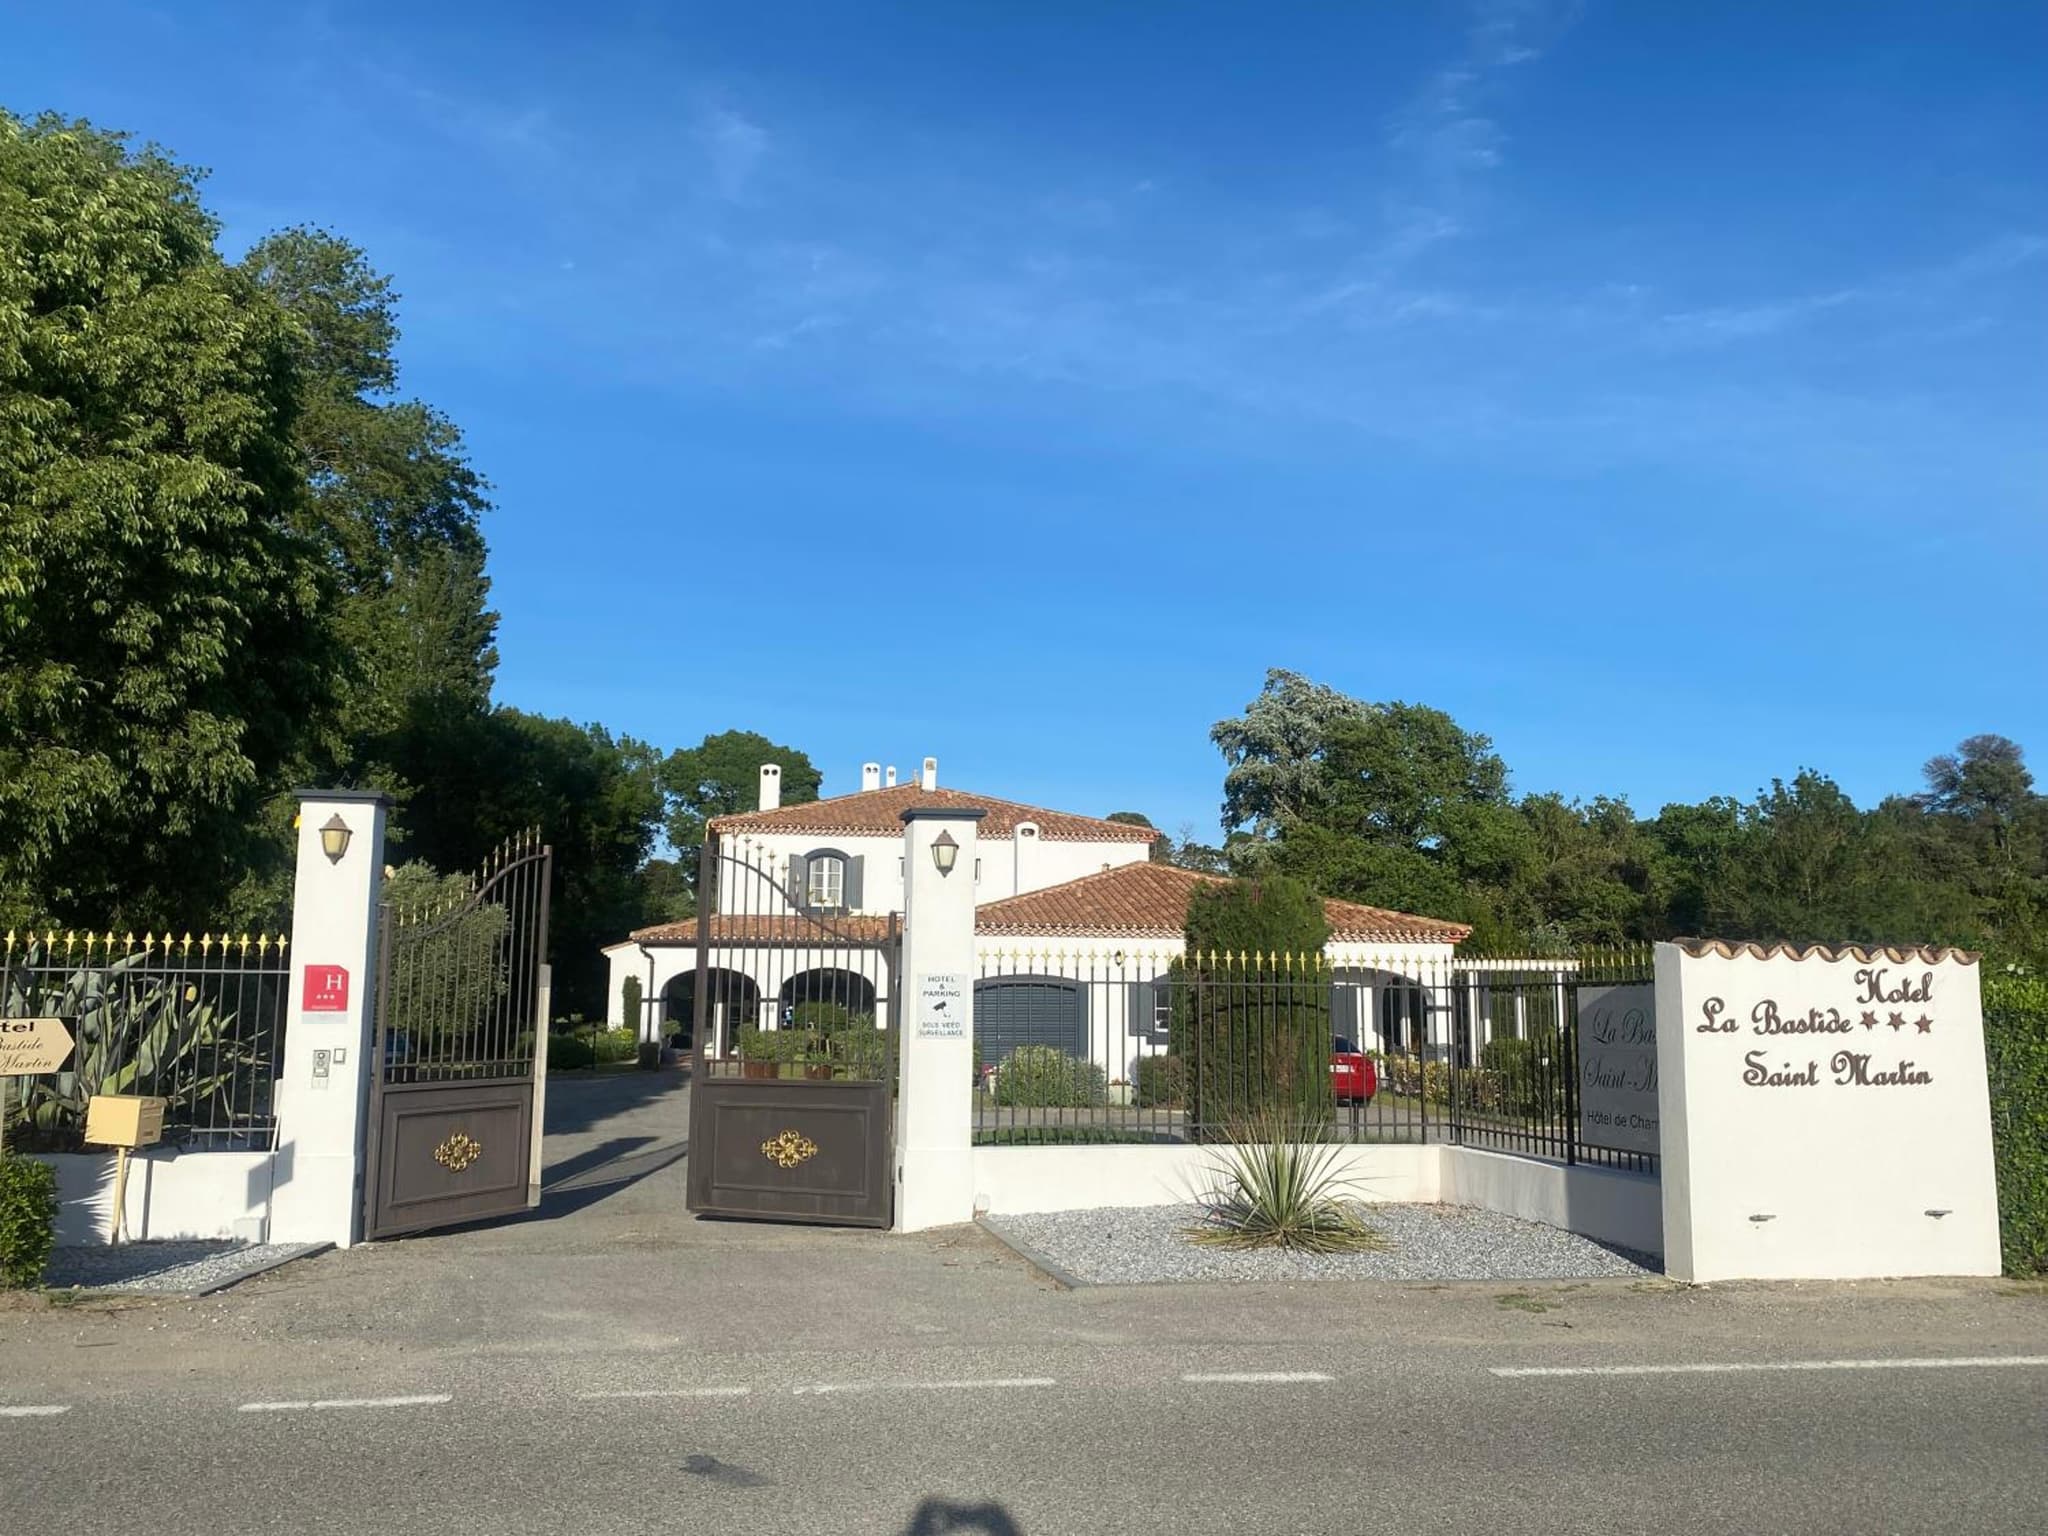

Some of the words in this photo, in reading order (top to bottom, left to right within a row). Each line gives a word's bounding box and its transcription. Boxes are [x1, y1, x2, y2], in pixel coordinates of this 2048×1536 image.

[326, 974, 343, 990] H
[927, 975, 956, 983] HOTEL
[1854, 968, 1934, 1004] Hotel
[922, 990, 961, 998] PARKING
[1592, 1007, 1617, 1044] La
[1696, 996, 1740, 1033] La
[1751, 999, 1854, 1035] Bastide
[1743, 1050, 1820, 1087] Saint
[1831, 1050, 1934, 1087] Martin
[1614, 1114, 1627, 1127] de
